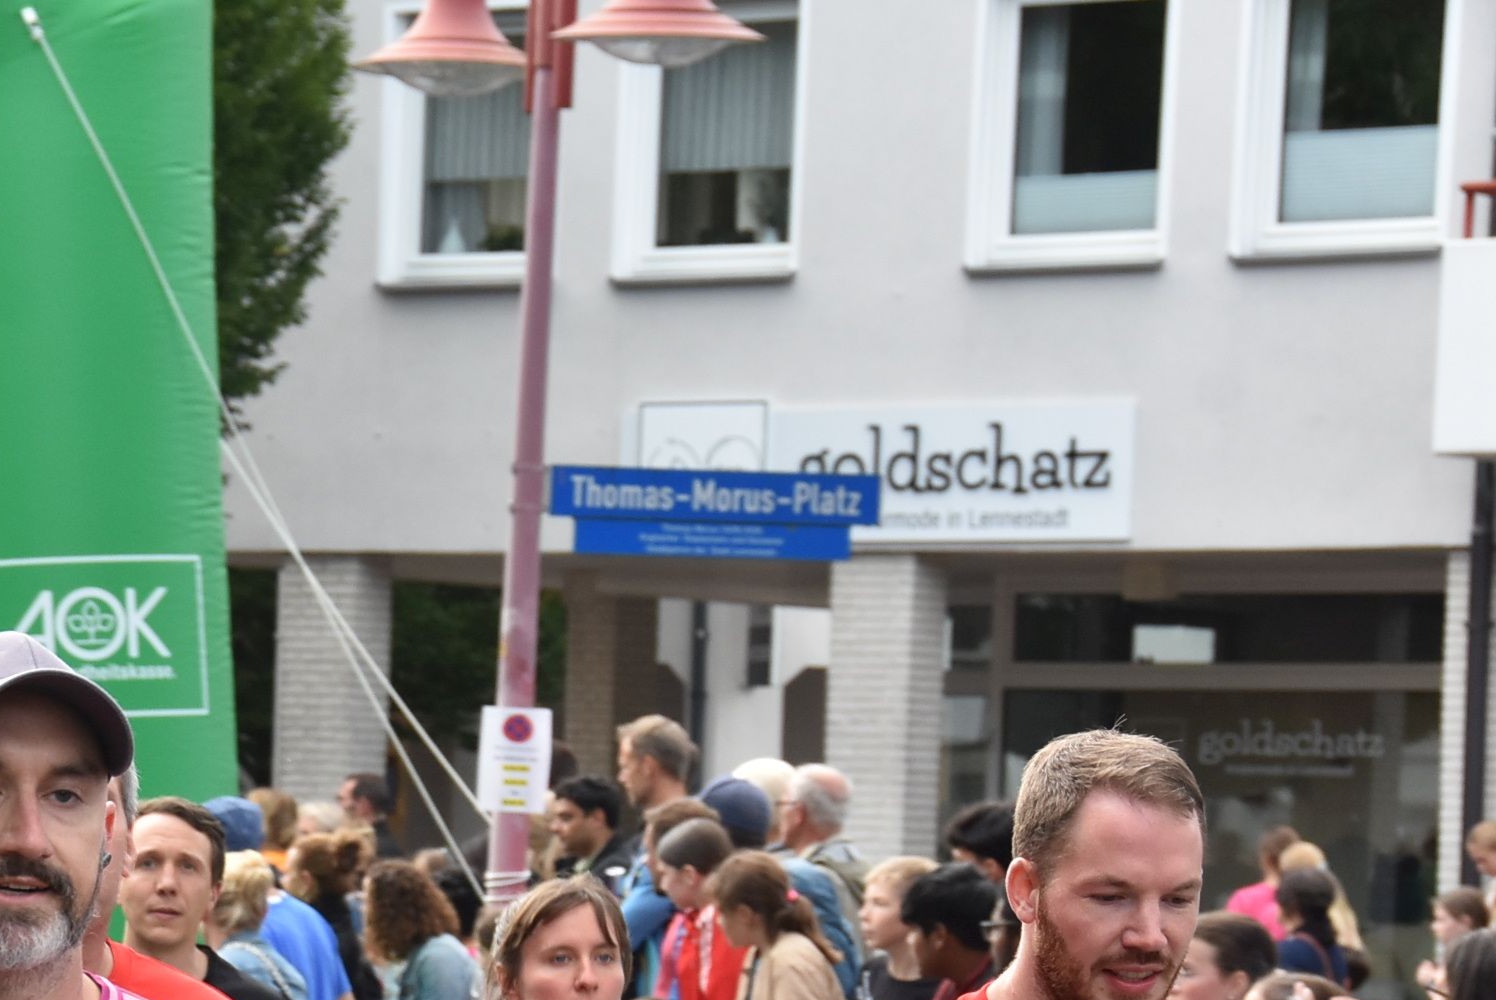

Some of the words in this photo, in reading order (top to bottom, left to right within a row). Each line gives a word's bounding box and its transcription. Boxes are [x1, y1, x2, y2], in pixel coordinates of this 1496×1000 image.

[570, 474, 863, 517] Thomas-Morus-Platz
[14, 586, 172, 661] AOK
[1199, 717, 1385, 765] goldschatz
